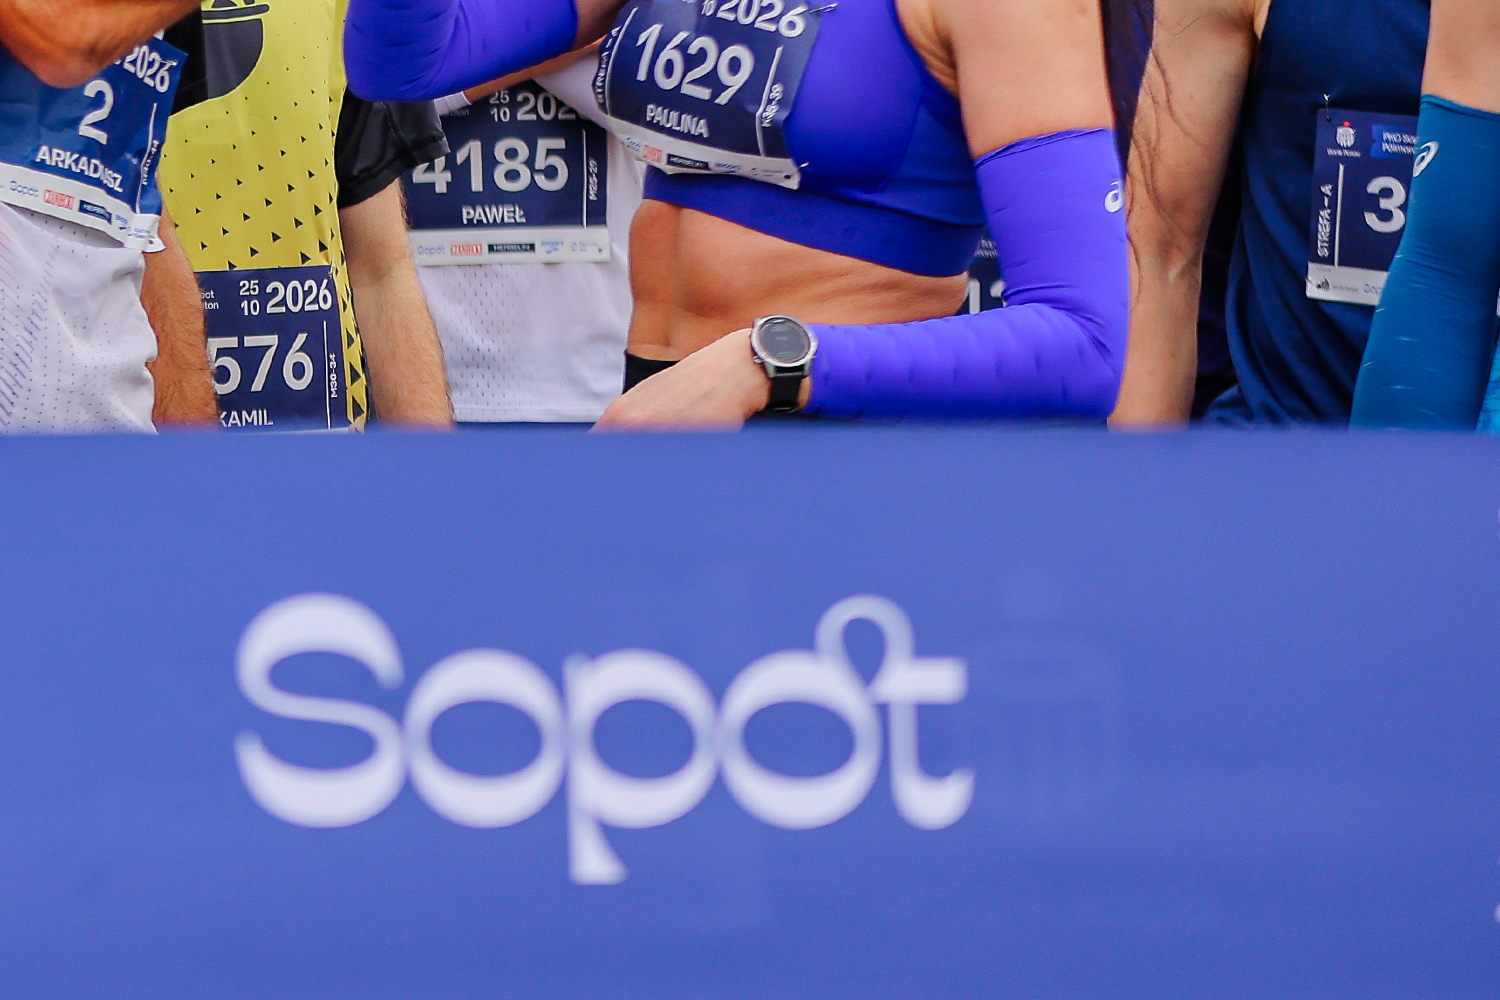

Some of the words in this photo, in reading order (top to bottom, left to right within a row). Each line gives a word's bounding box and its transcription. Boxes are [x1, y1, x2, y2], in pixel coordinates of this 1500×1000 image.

[701, 0, 718, 17] 10
[122, 44, 173, 93] 2026
[635, 22, 756, 106] 1629
[78, 78, 114, 145] 2
[488, 90, 511, 104] 25
[490, 107, 511, 122] 10
[516, 91, 582, 122] 202
[645, 104, 710, 139] PAULINA
[412, 137, 569, 194] 4185
[461, 203, 527, 225] PAWEŁ
[1364, 175, 1407, 233] 3
[239, 280, 260, 296] 25
[265, 278, 332, 314] 2026
[241, 300, 260, 316] 10
[330, 353, 339, 398] M30-34
[234, 592, 978, 887] Sopot
